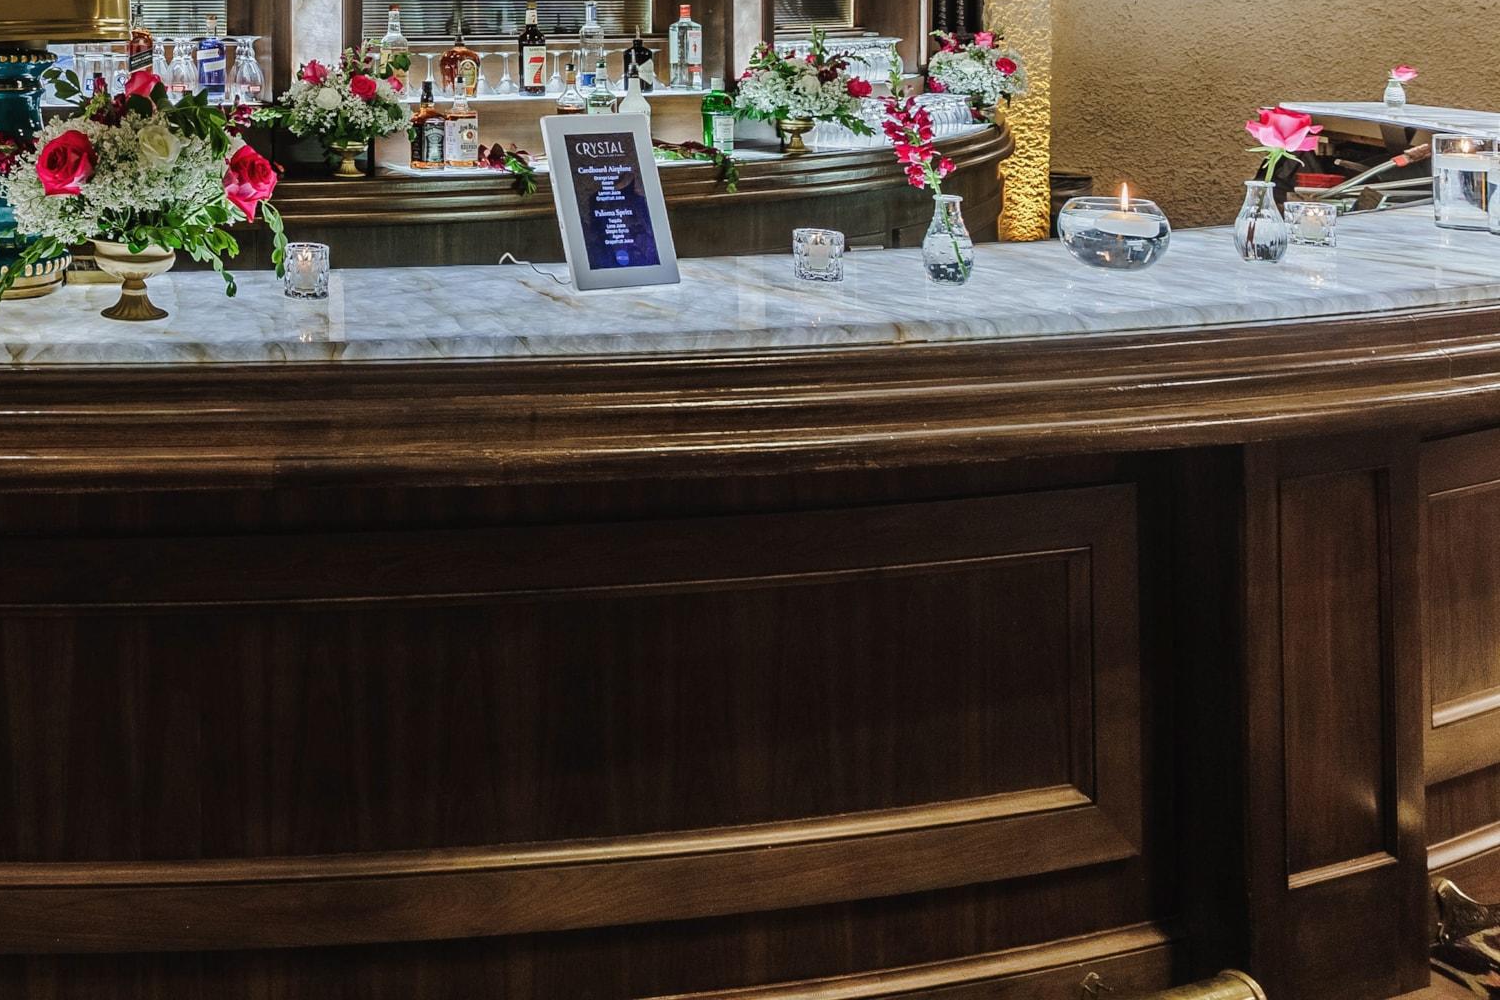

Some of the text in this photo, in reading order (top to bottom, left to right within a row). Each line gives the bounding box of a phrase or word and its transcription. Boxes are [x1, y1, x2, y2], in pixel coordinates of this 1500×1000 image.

[529, 56, 545, 84] 7
[575, 141, 625, 158] CRYSTAL
[577, 164, 632, 175] Cardboard Airplane
[594, 208, 633, 217] Paloma Spritz
